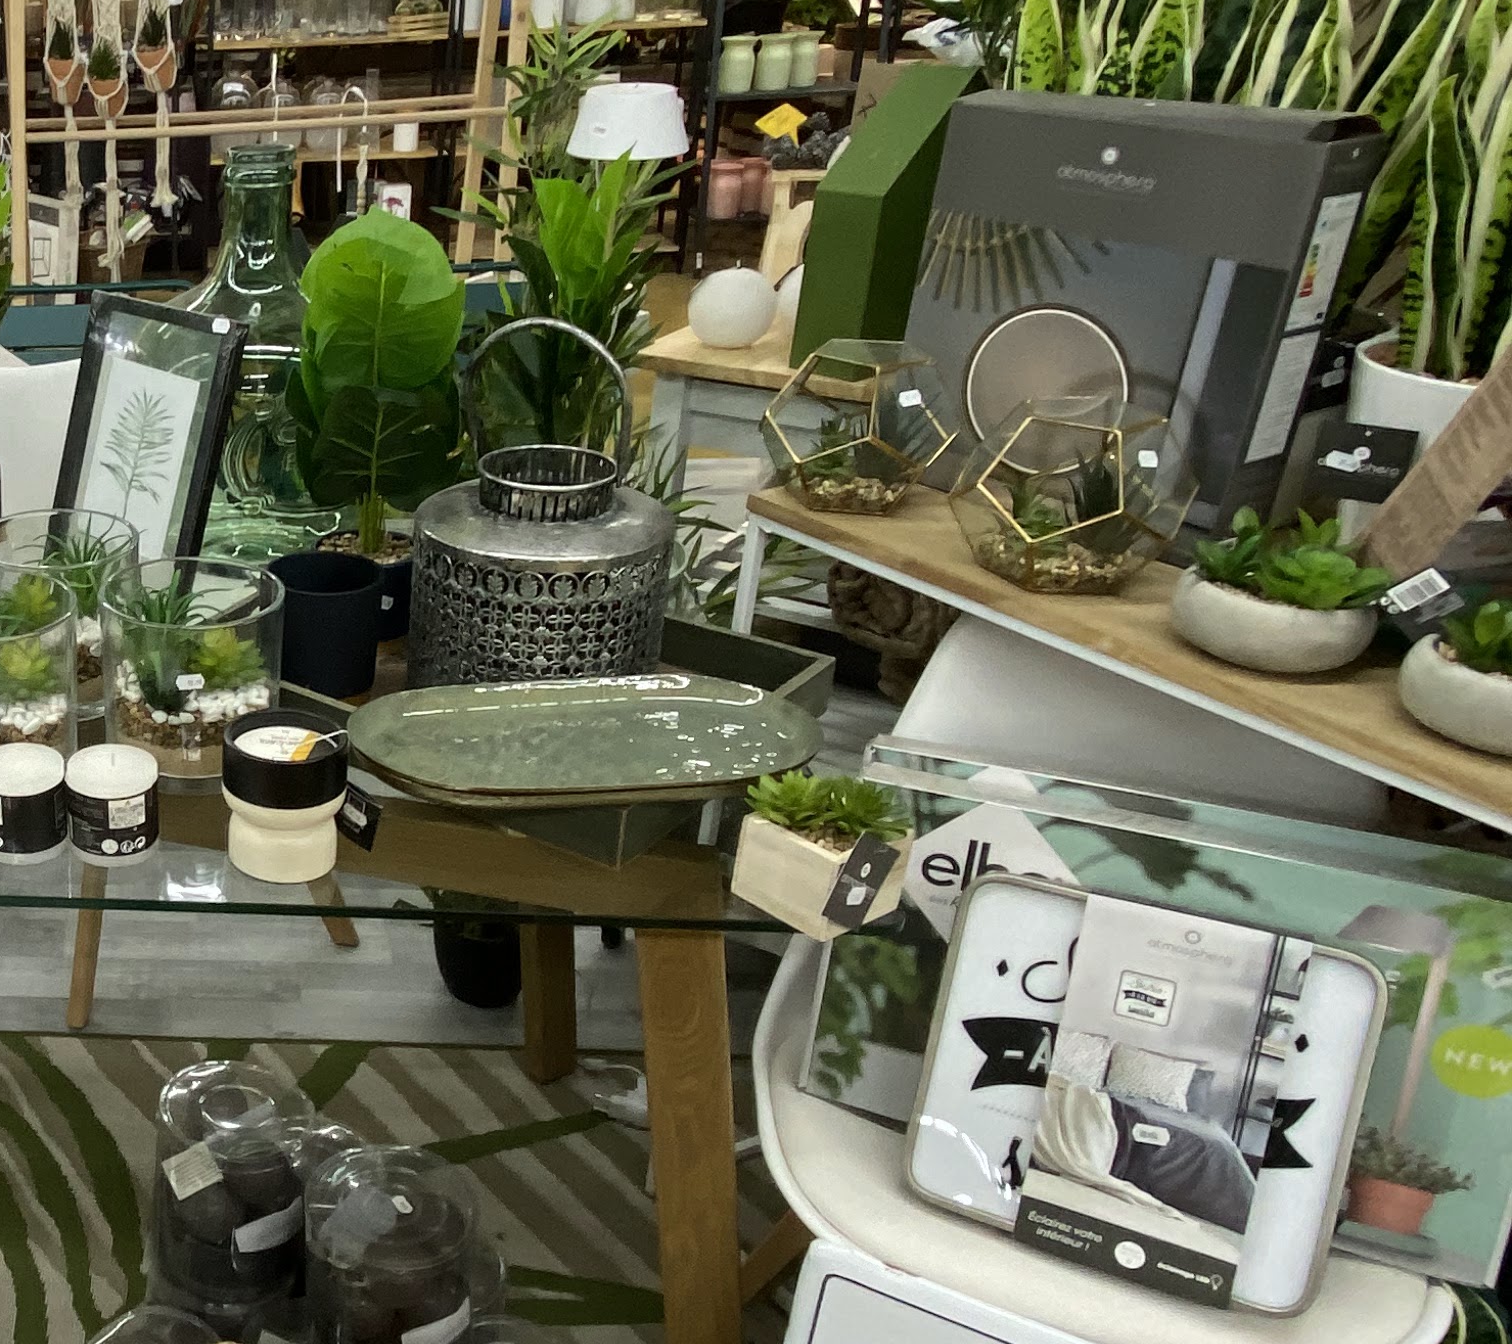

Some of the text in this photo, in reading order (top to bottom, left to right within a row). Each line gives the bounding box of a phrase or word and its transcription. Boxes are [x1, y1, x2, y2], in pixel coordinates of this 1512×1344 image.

[922, 839, 1050, 891] elh
[1445, 1047, 1512, 1076] NEW
[1027, 1210, 1103, 1243] Éclairez votre
